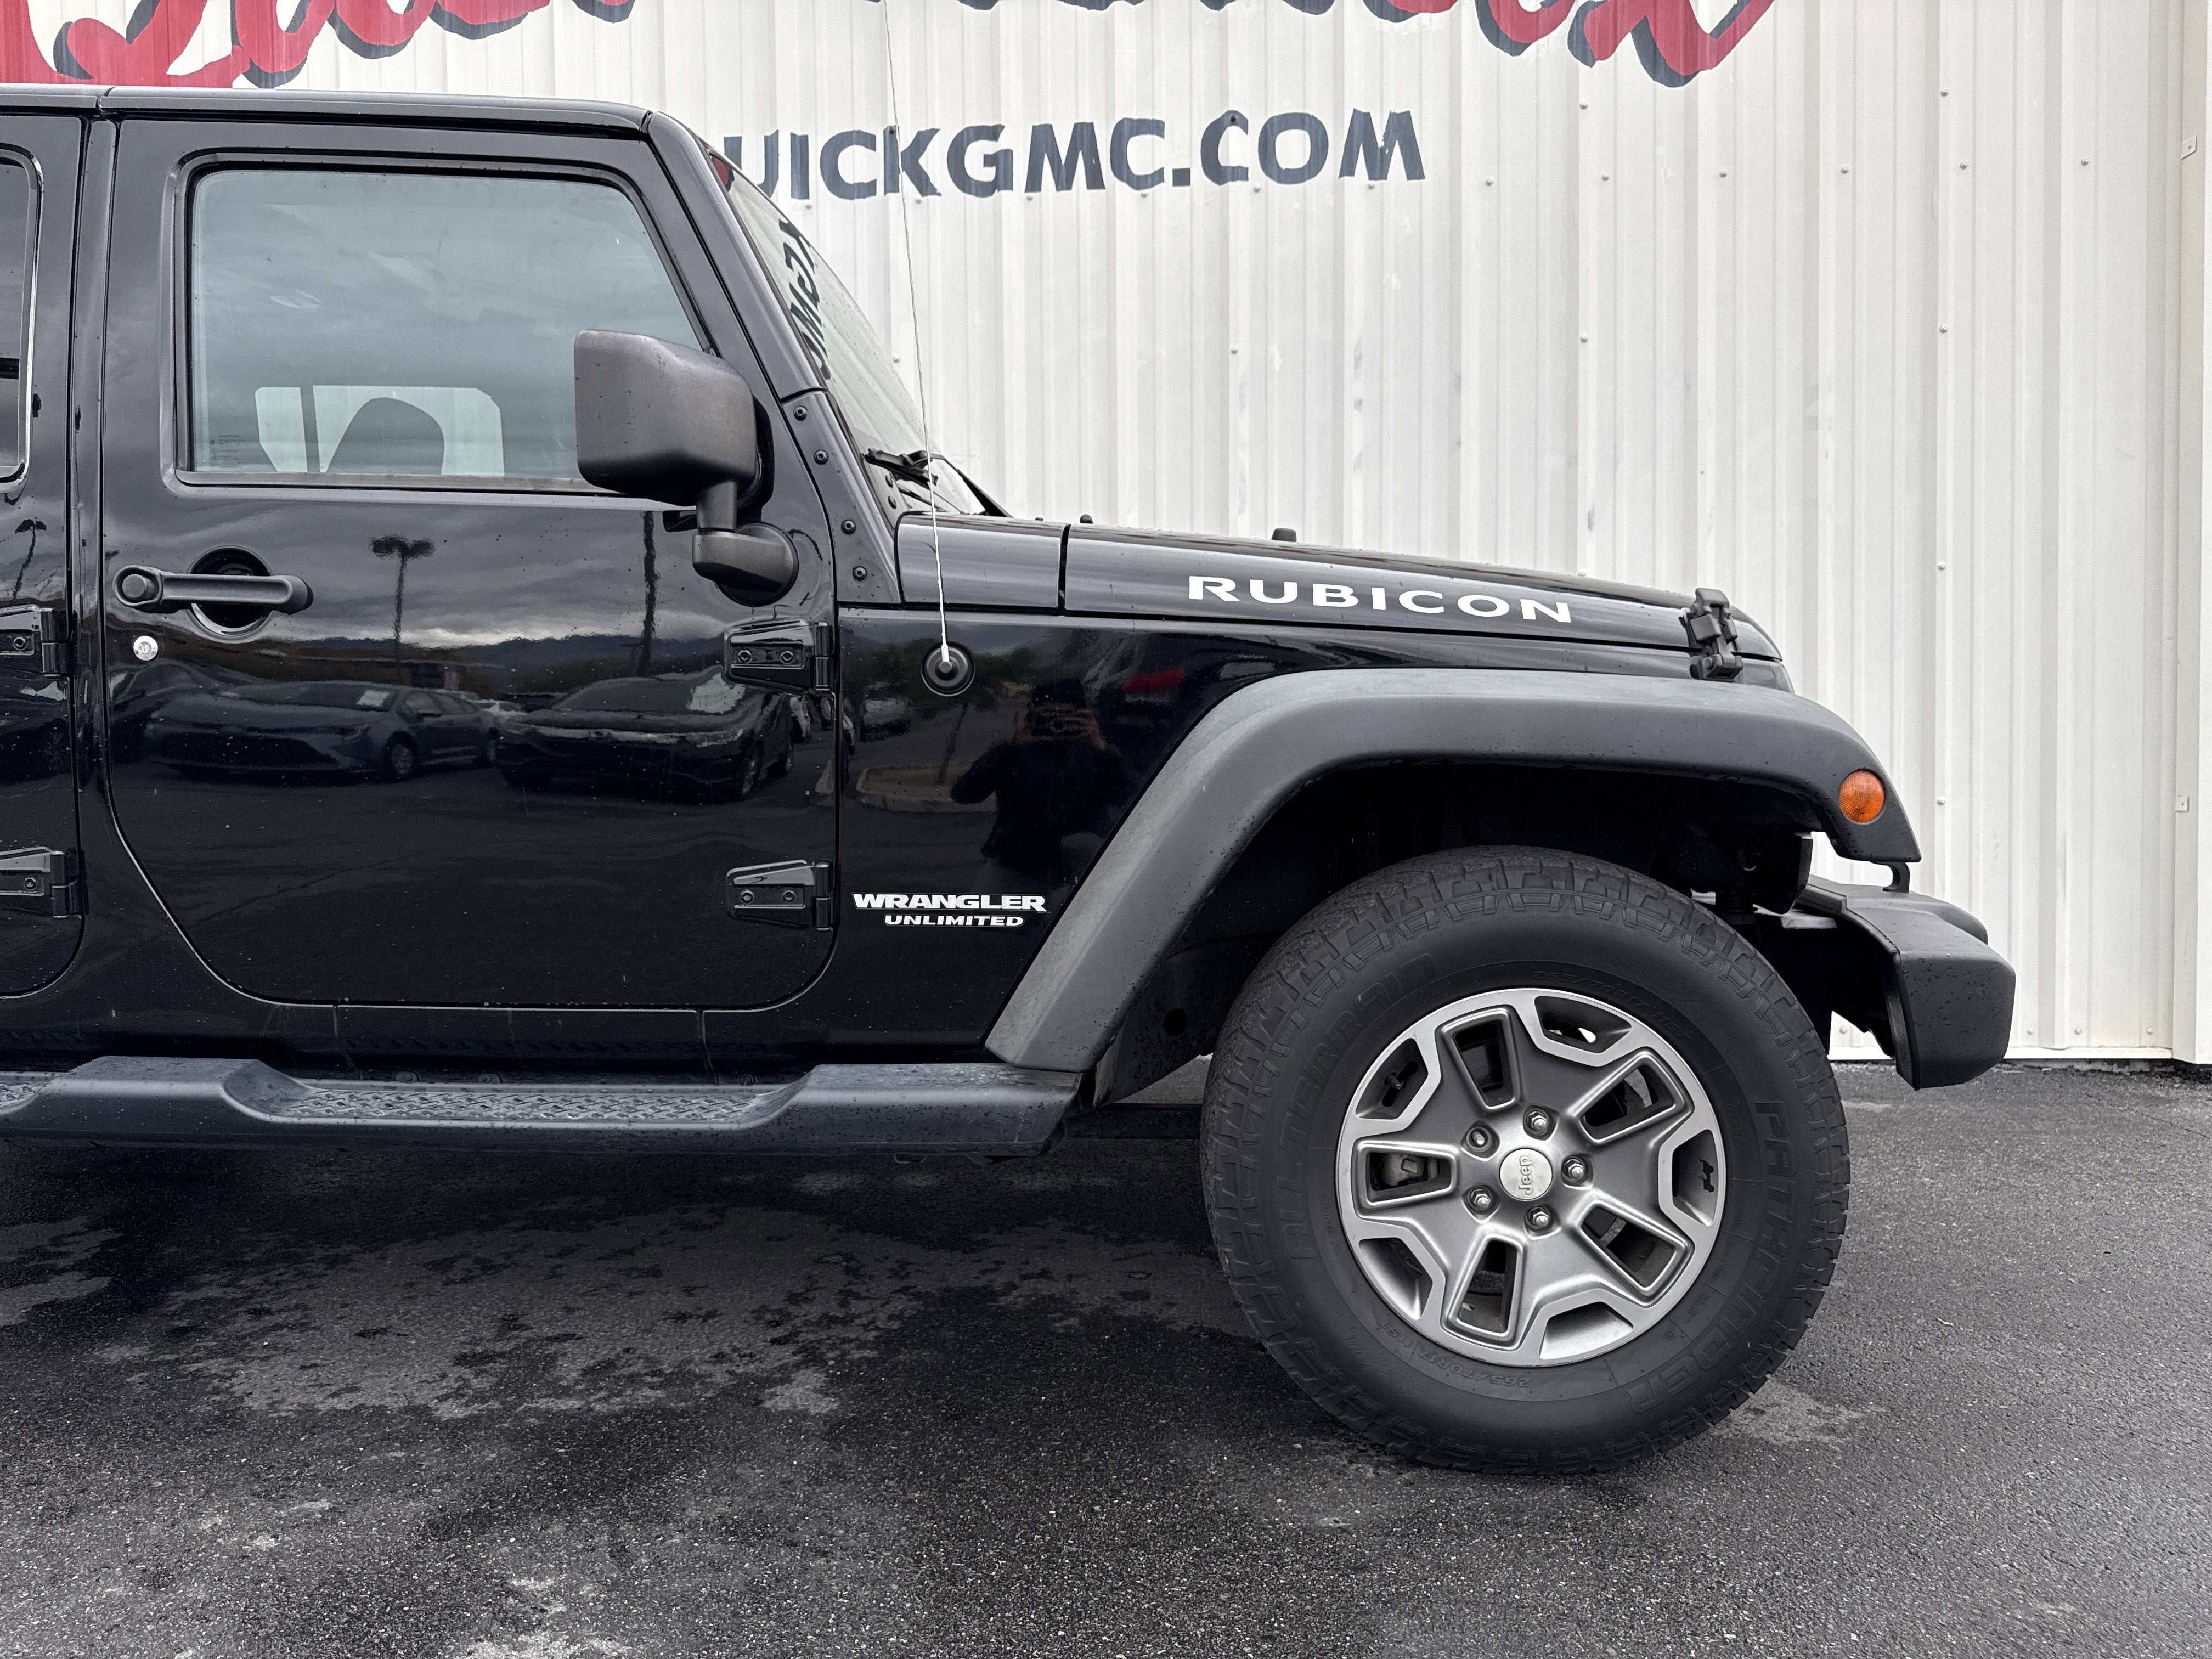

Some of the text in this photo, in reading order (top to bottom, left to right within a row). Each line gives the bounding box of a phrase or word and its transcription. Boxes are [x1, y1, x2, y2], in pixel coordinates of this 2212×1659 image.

[1188, 575, 1572, 623] RUBICON
[853, 894, 1047, 912] WRANGLER
[884, 915, 1024, 926] UNLIMITED
[1531, 970, 1650, 1012] 265/70R17
[1280, 951, 1439, 1150] TERRAIN
[1519, 1155, 1533, 1195] Jeep
[1277, 1161, 1317, 1266] ALL
[1624, 1094, 1795, 1417] PATHFINDER
[1375, 1314, 1531, 1387] 265/70R17 115T
